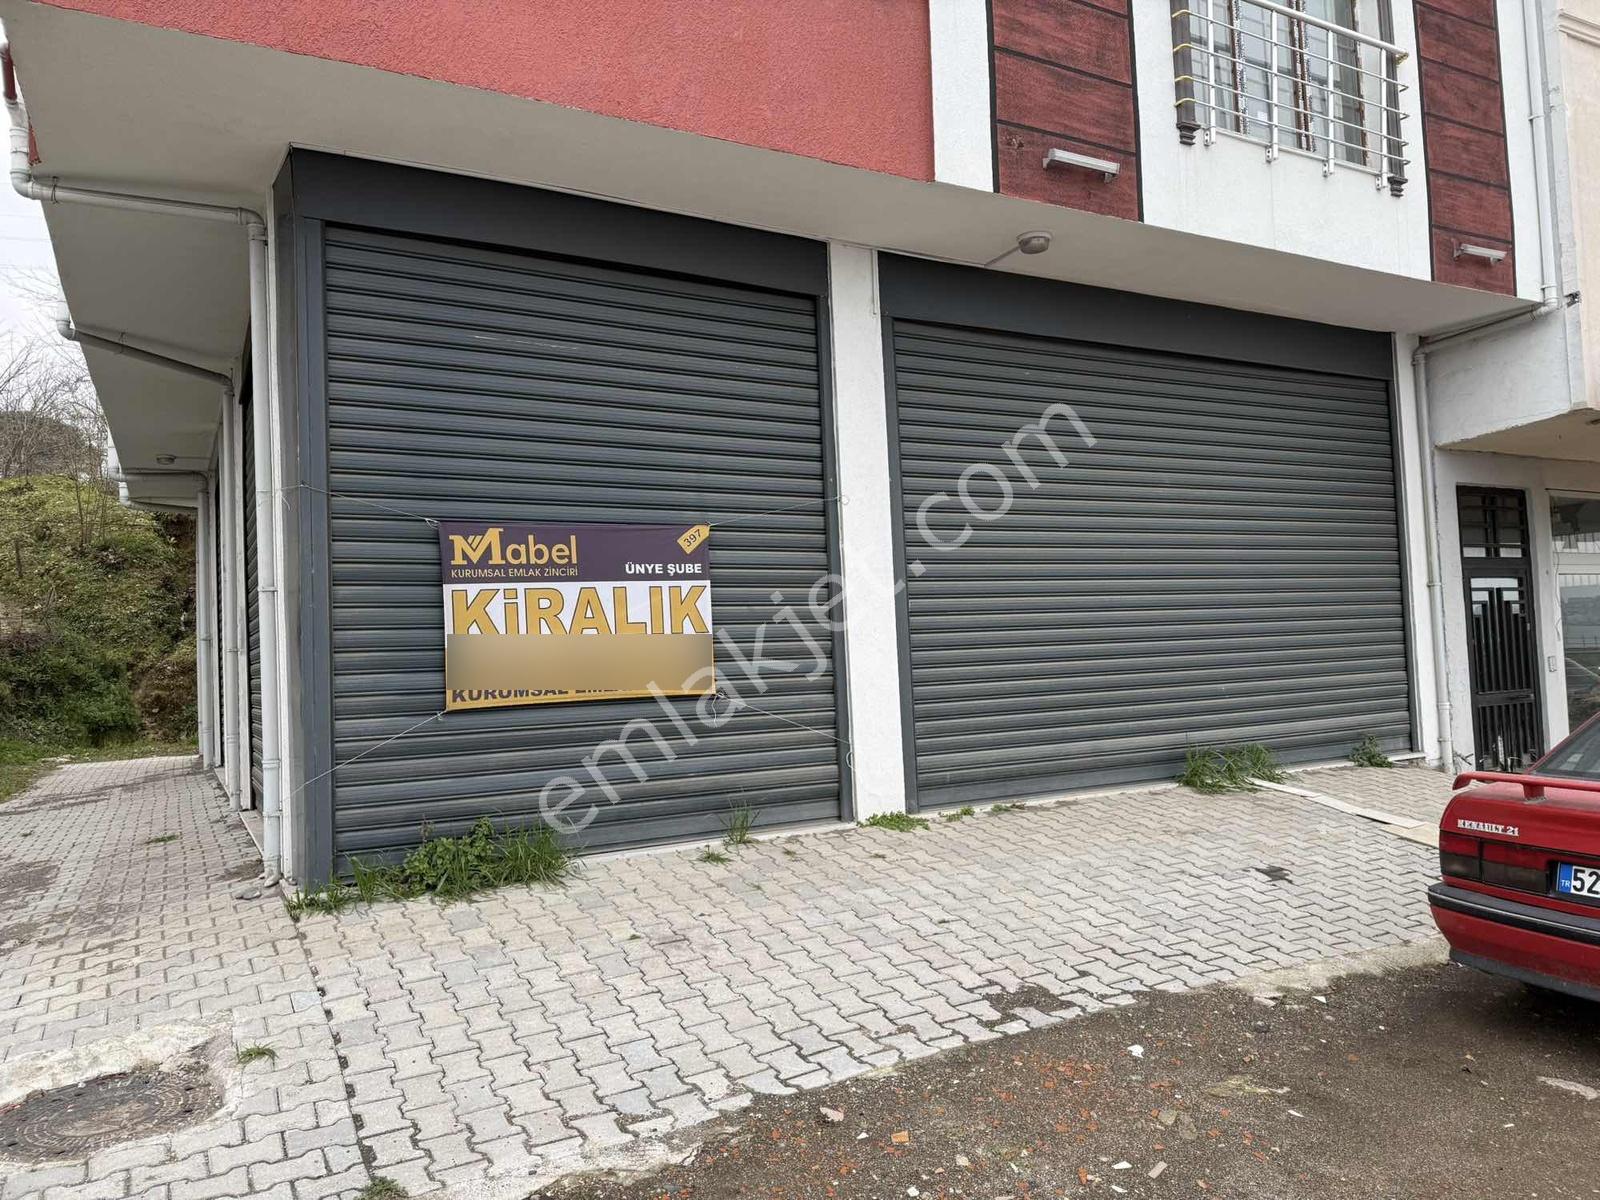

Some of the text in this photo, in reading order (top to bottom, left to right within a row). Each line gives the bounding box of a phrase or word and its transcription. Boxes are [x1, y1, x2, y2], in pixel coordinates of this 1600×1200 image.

[683, 529, 702, 547] 397
[449, 528, 578, 565] Mabel
[451, 568, 506, 578] KURUMSAL
[508, 568, 541, 577] EMLAK
[625, 562, 702, 576] ÜNYE ŞUBE
[1561, 879, 1570, 887] TR
[1572, 868, 1600, 895] 52
